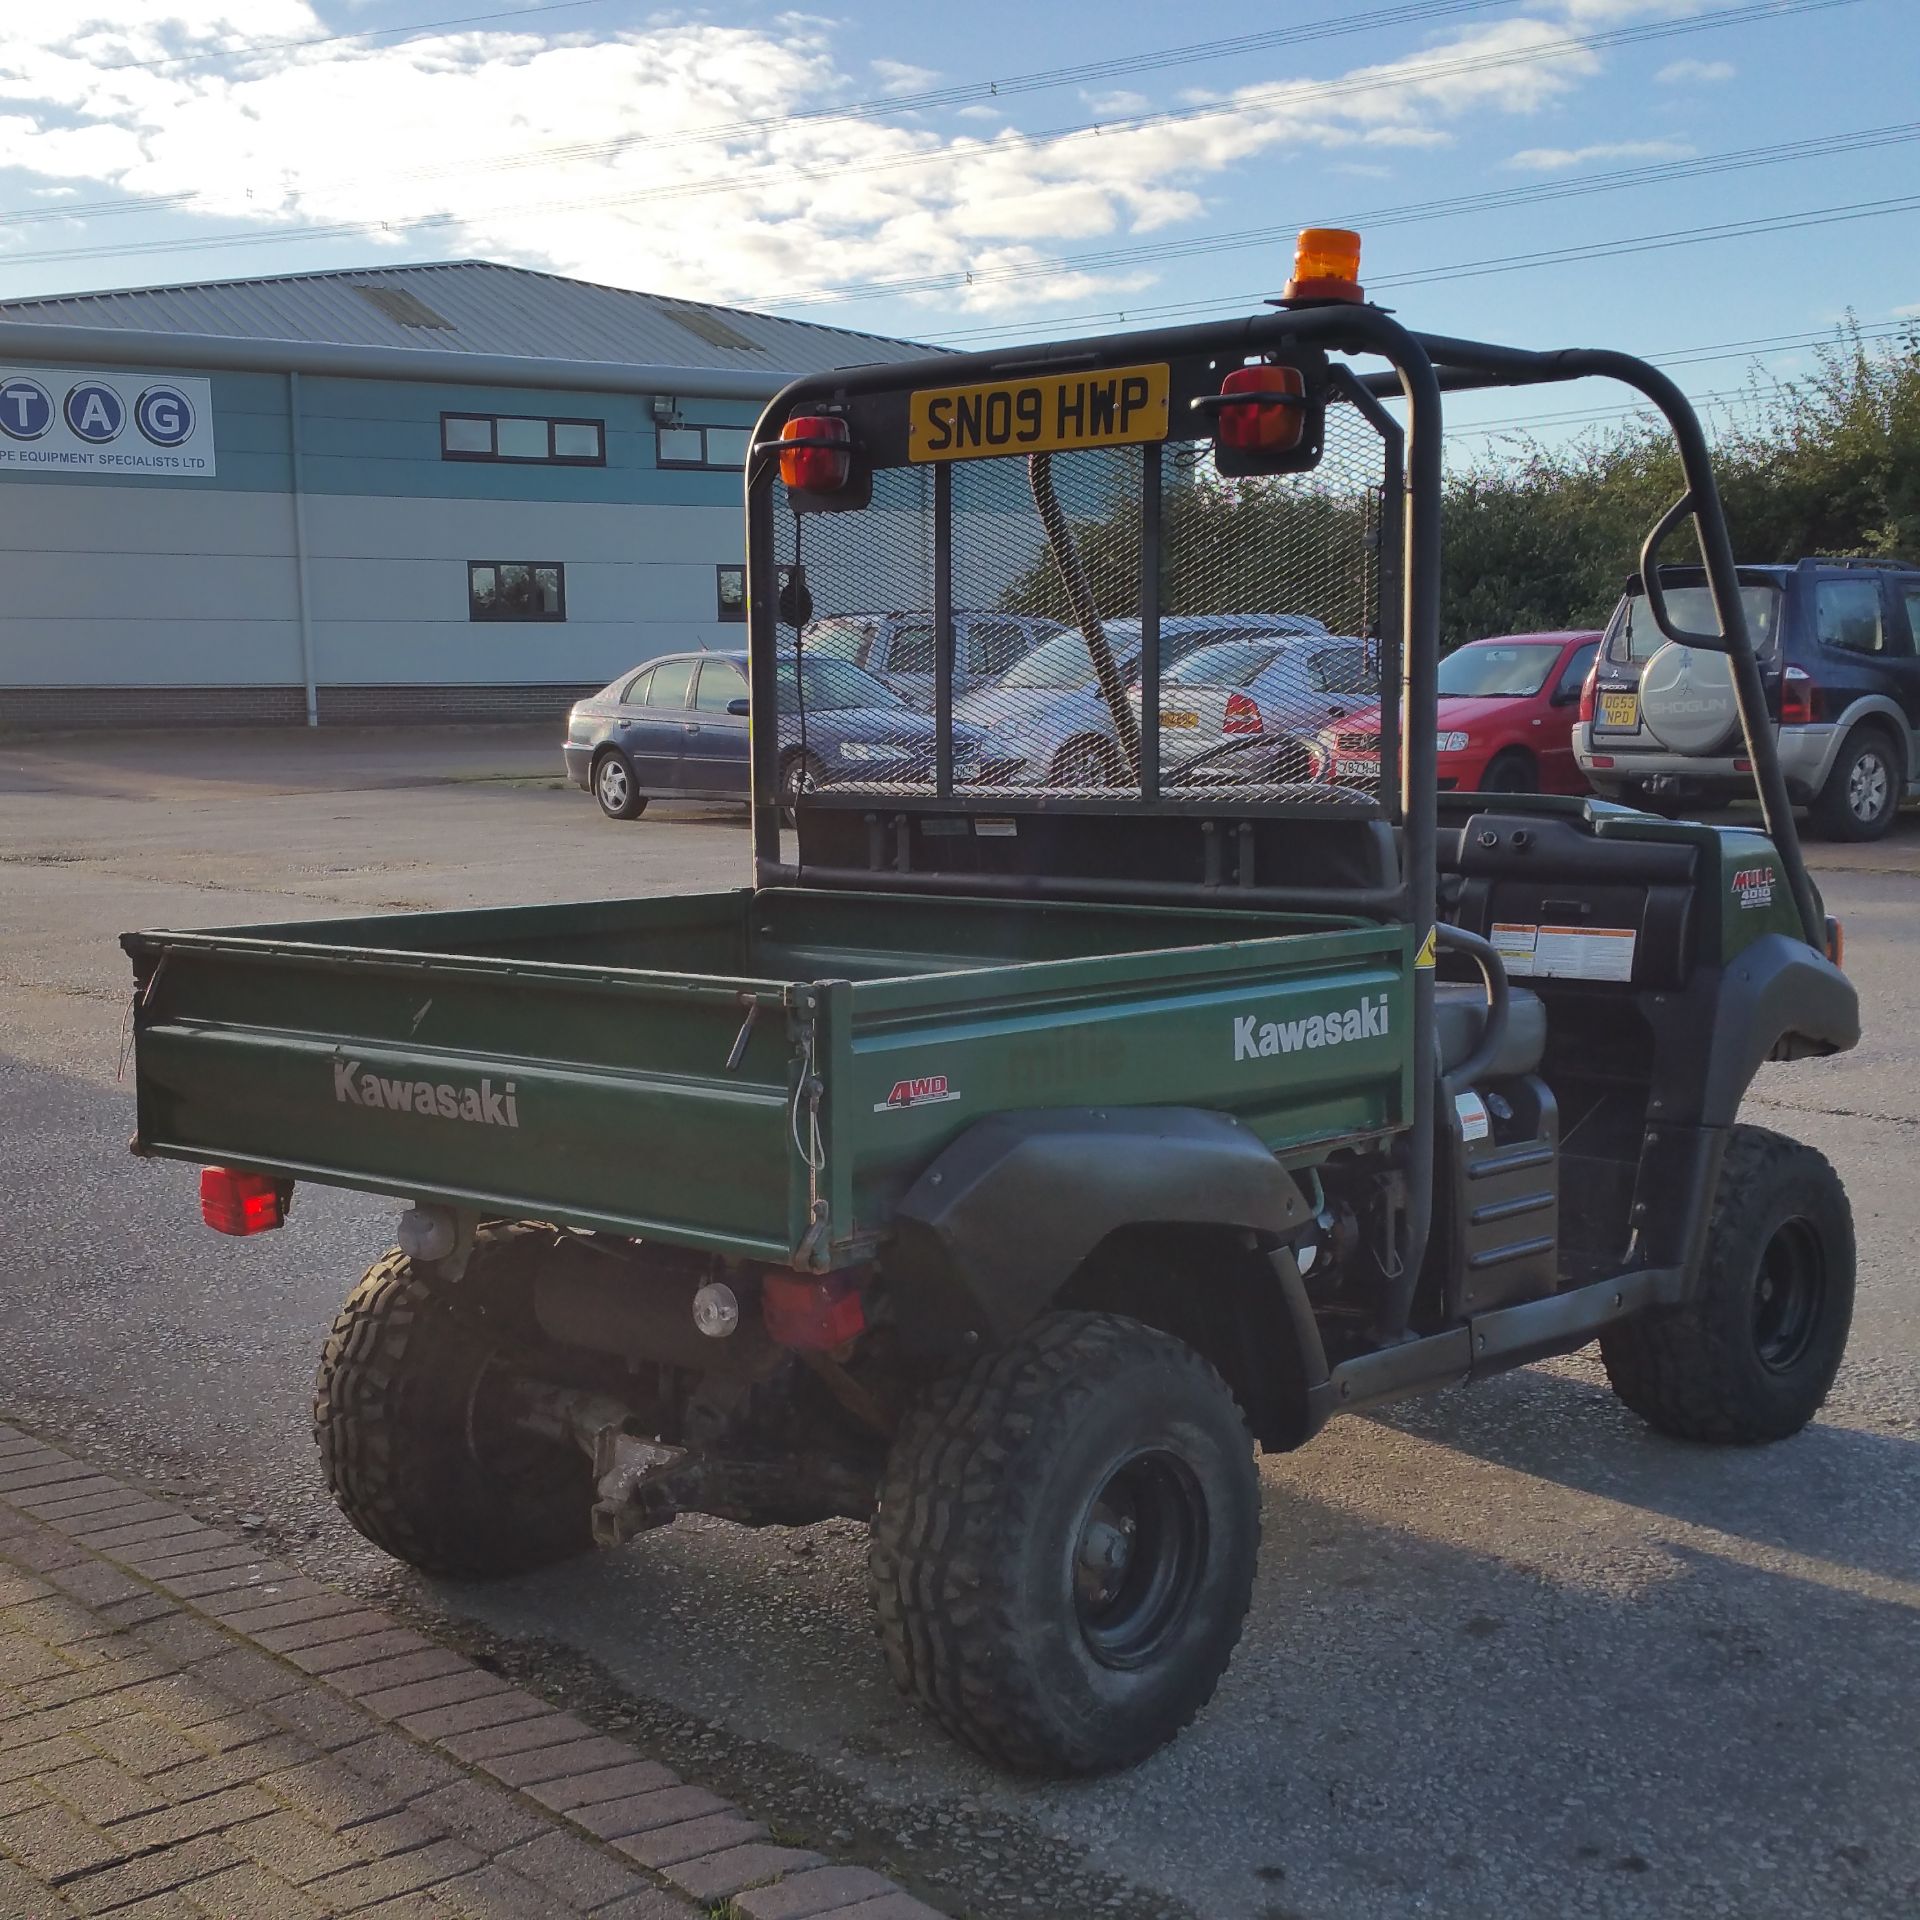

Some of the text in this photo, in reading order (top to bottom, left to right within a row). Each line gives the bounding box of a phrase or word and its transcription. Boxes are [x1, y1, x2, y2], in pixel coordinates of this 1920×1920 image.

[927, 376, 1149, 450] SN09 HWP
[19, 450, 95, 464] EQUIPMENT
[98, 454, 180, 467] SPECIALISTS
[182, 458, 205, 469] LTD
[1650, 699, 1728, 715] SHOGUN
[1234, 993, 1389, 1061] Kawasaki
[333, 1060, 519, 1128] Kawasaki
[887, 1075, 949, 1108] 4WD
